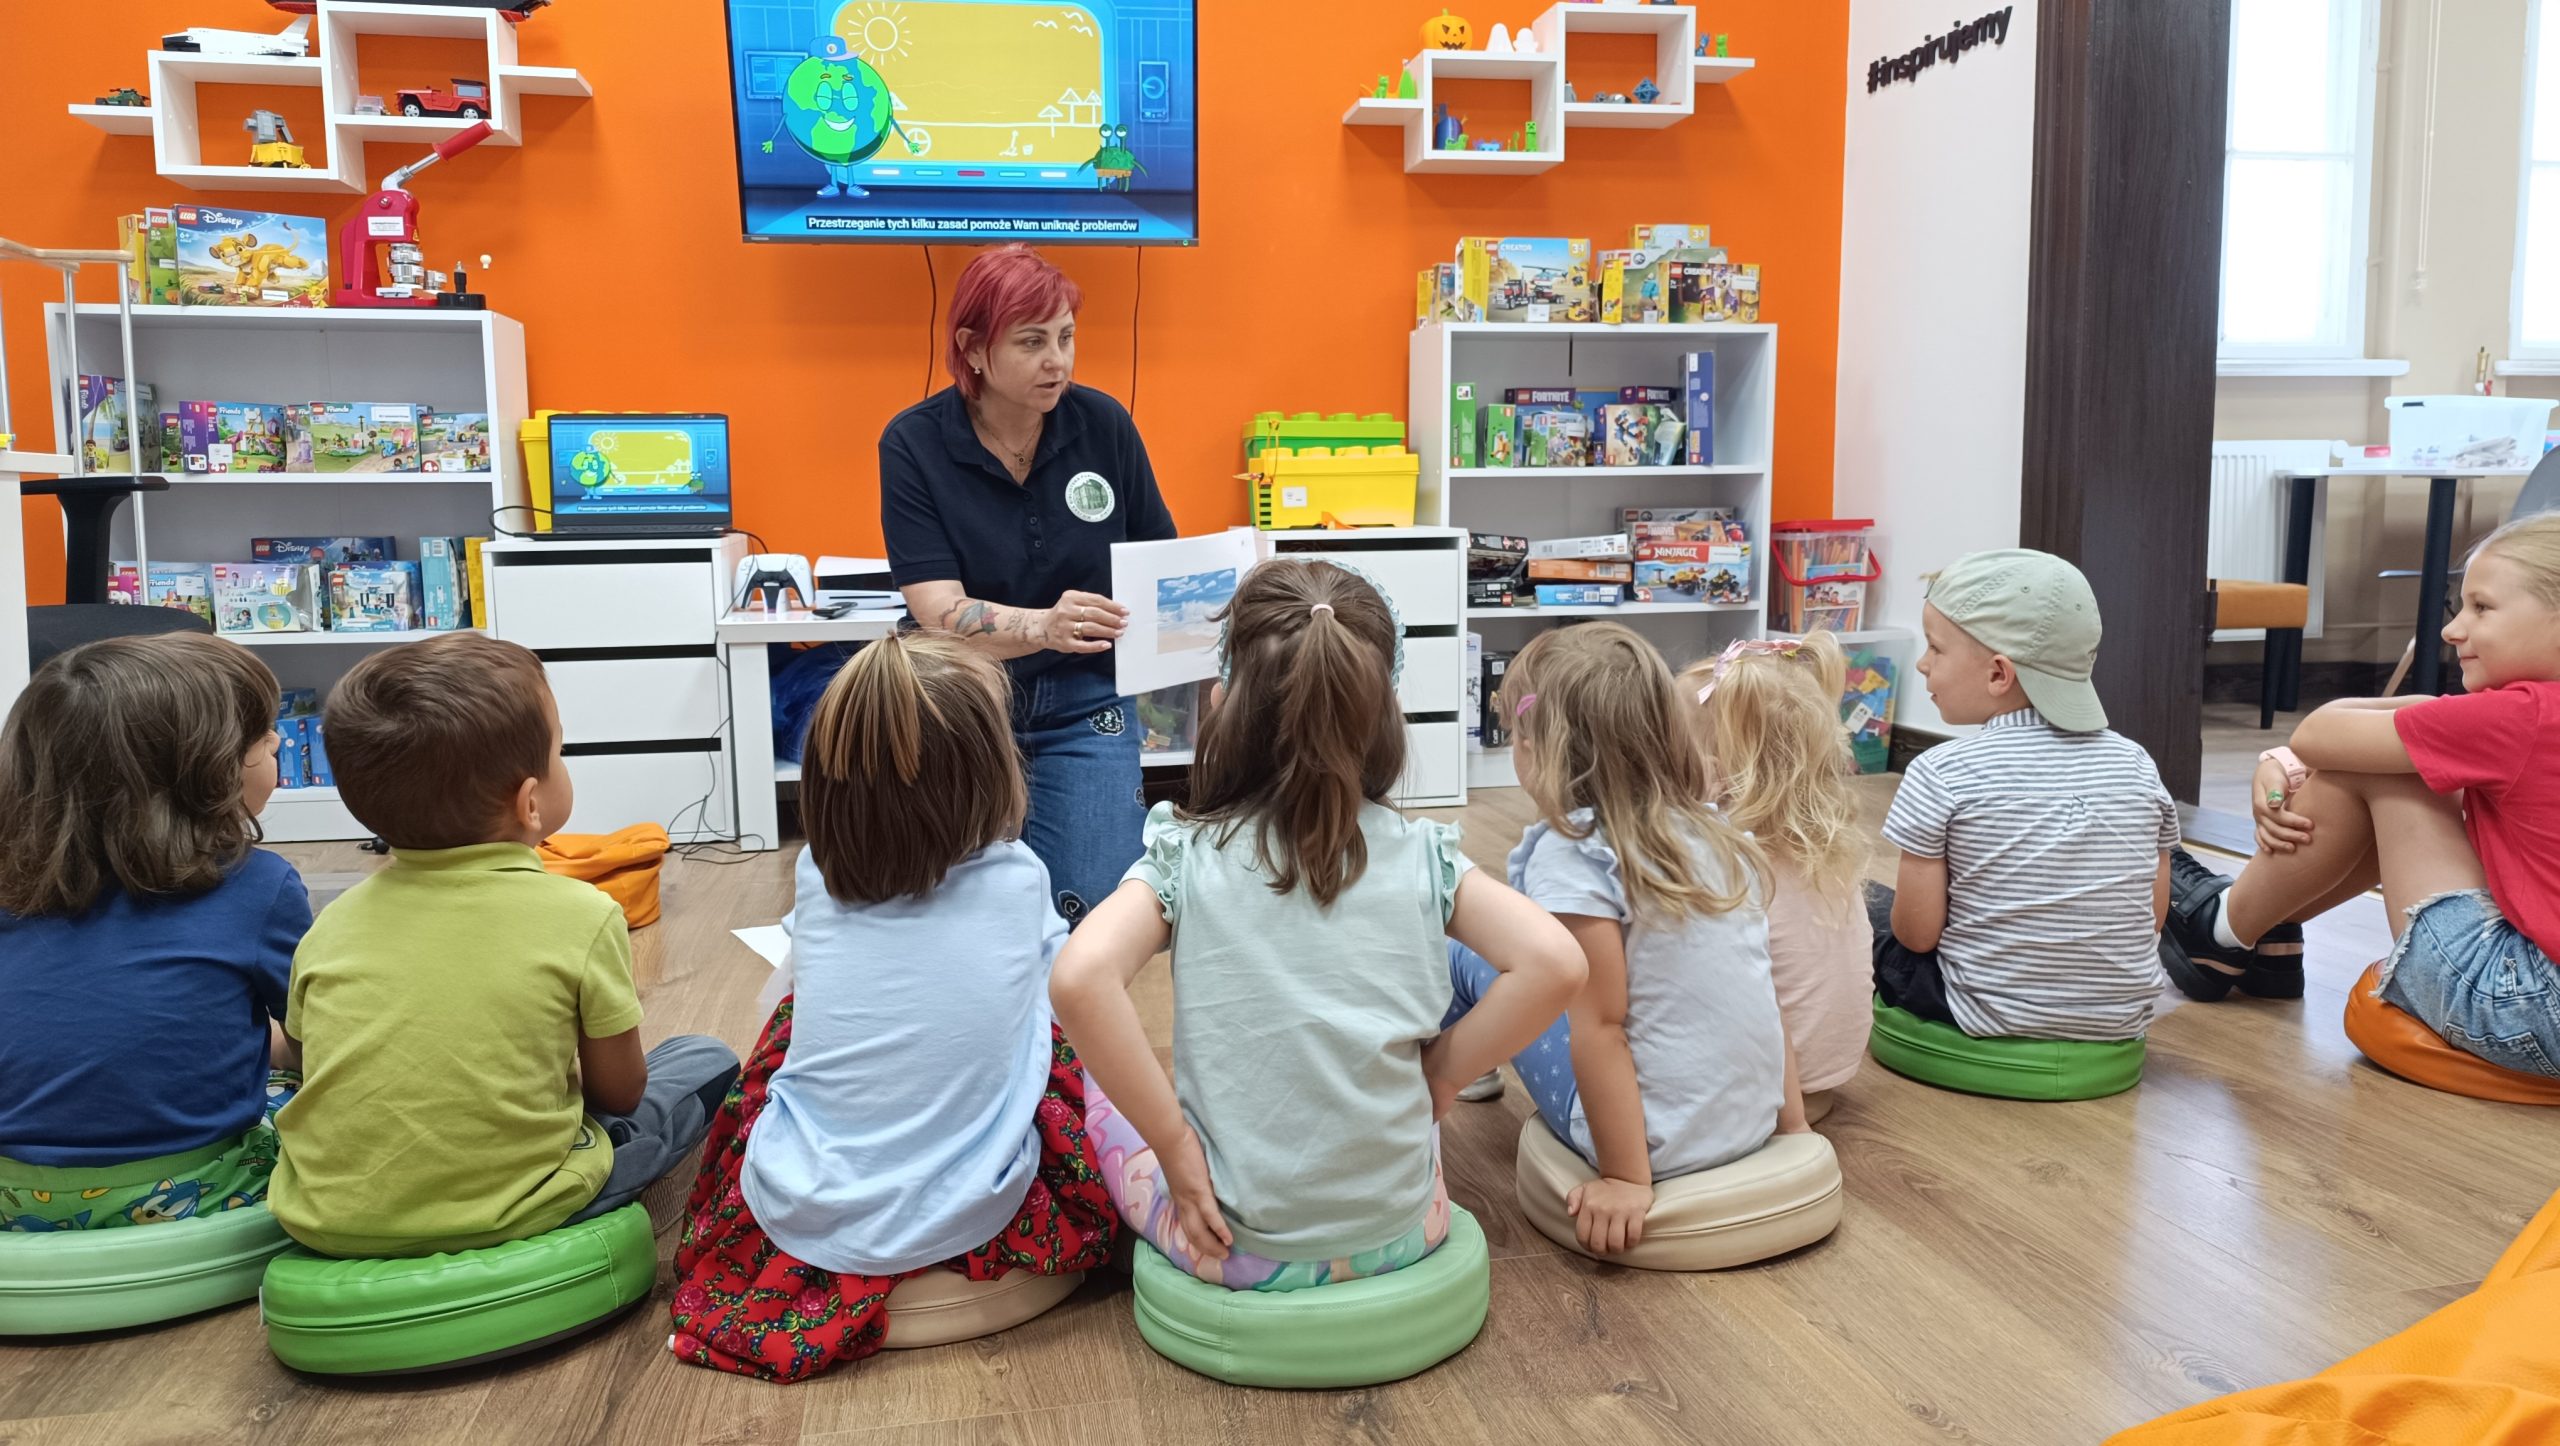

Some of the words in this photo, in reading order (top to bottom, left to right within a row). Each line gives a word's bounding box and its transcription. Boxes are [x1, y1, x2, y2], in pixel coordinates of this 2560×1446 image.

[1867, 6, 2013, 94] #inspirujemy
[179, 212, 197, 220] LEGO
[200, 210, 243, 229] Disney
[808, 217, 885, 230] Przestrzeganie
[887, 218, 909, 231] tych
[911, 218, 935, 230] kilku
[937, 219, 968, 230] zasad
[970, 219, 1011, 232] pomoże
[1012, 220, 1039, 230] Wam
[1041, 220, 1080, 232] uniknąć
[1082, 220, 1137, 232] problemów
[1532, 391, 1570, 403] FORTNITE
[219, 406, 242, 415] Friends
[272, 540, 310, 555] Disney
[1653, 547, 1699, 559] NINJAGO
